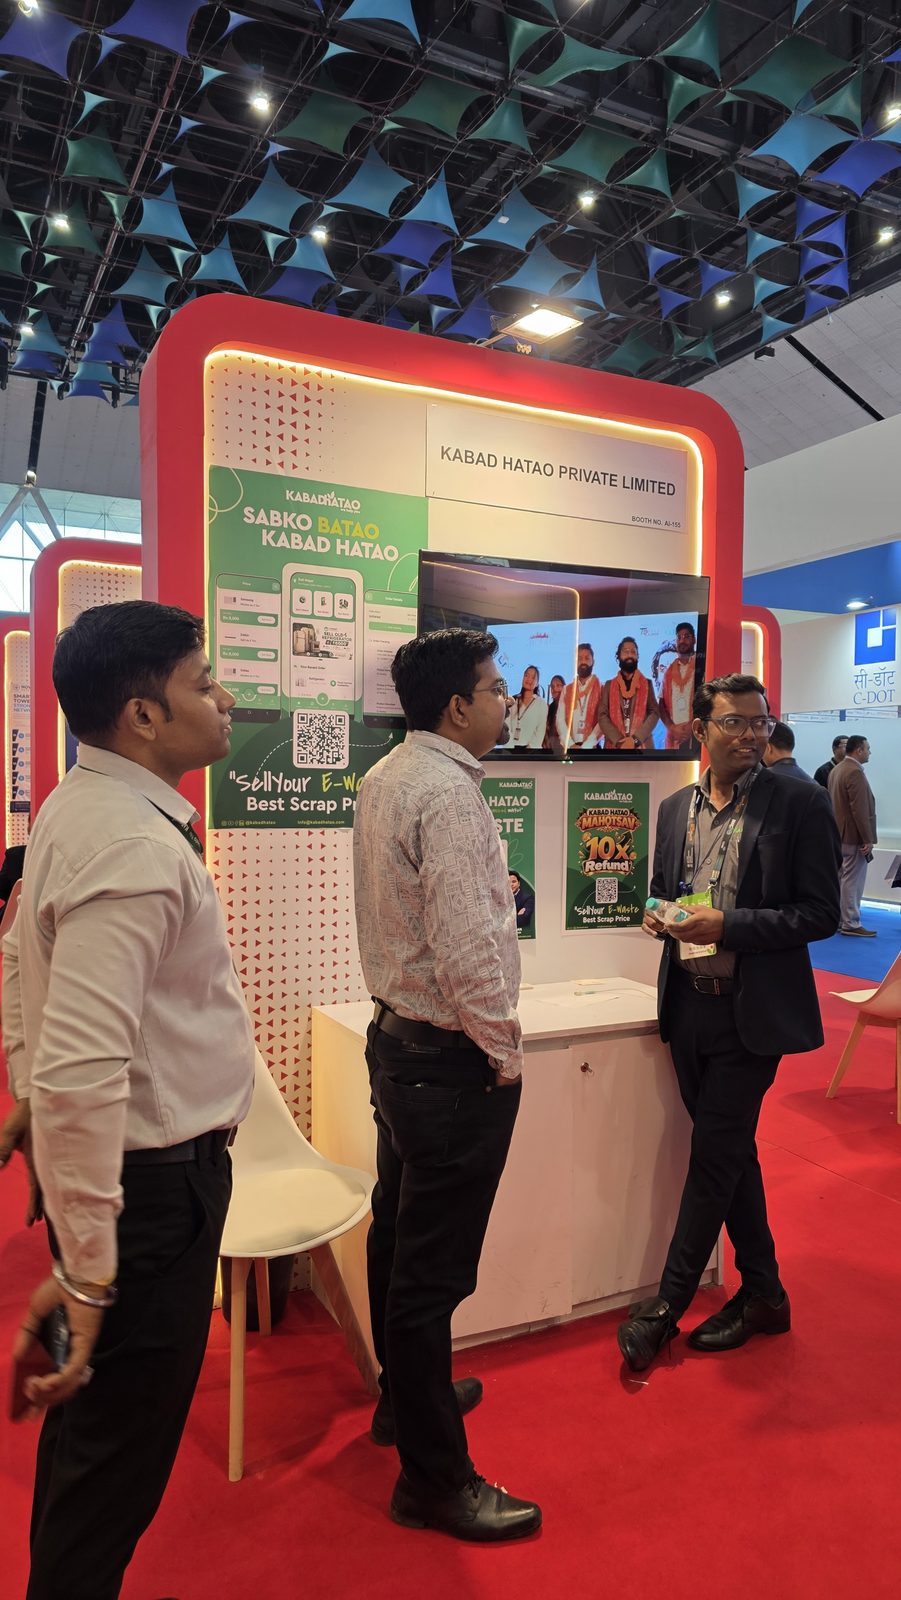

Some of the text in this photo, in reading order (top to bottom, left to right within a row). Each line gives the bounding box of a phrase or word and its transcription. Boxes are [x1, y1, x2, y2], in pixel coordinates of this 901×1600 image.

[441, 445, 676, 497] KABAD HATAO PRIVATE LIMITED
[243, 506, 380, 540] SABKO BATAO
[631, 515, 652, 524] BOOTH
[261, 529, 399, 561] KABAD HATAO
[853, 667, 896, 689] सी-डॉट
[853, 689, 896, 704] C-DOT
[322, 771, 364, 793] E-Wa
[246, 797, 357, 814] Best Scrap Pr
[489, 796, 530, 807] HATAO
[496, 818, 524, 833] STE
[581, 816, 636, 830] MAHOTSAV
[586, 836, 630, 861] 10x
[585, 861, 630, 873] Refund
[608, 904, 640, 914] E-Waste
